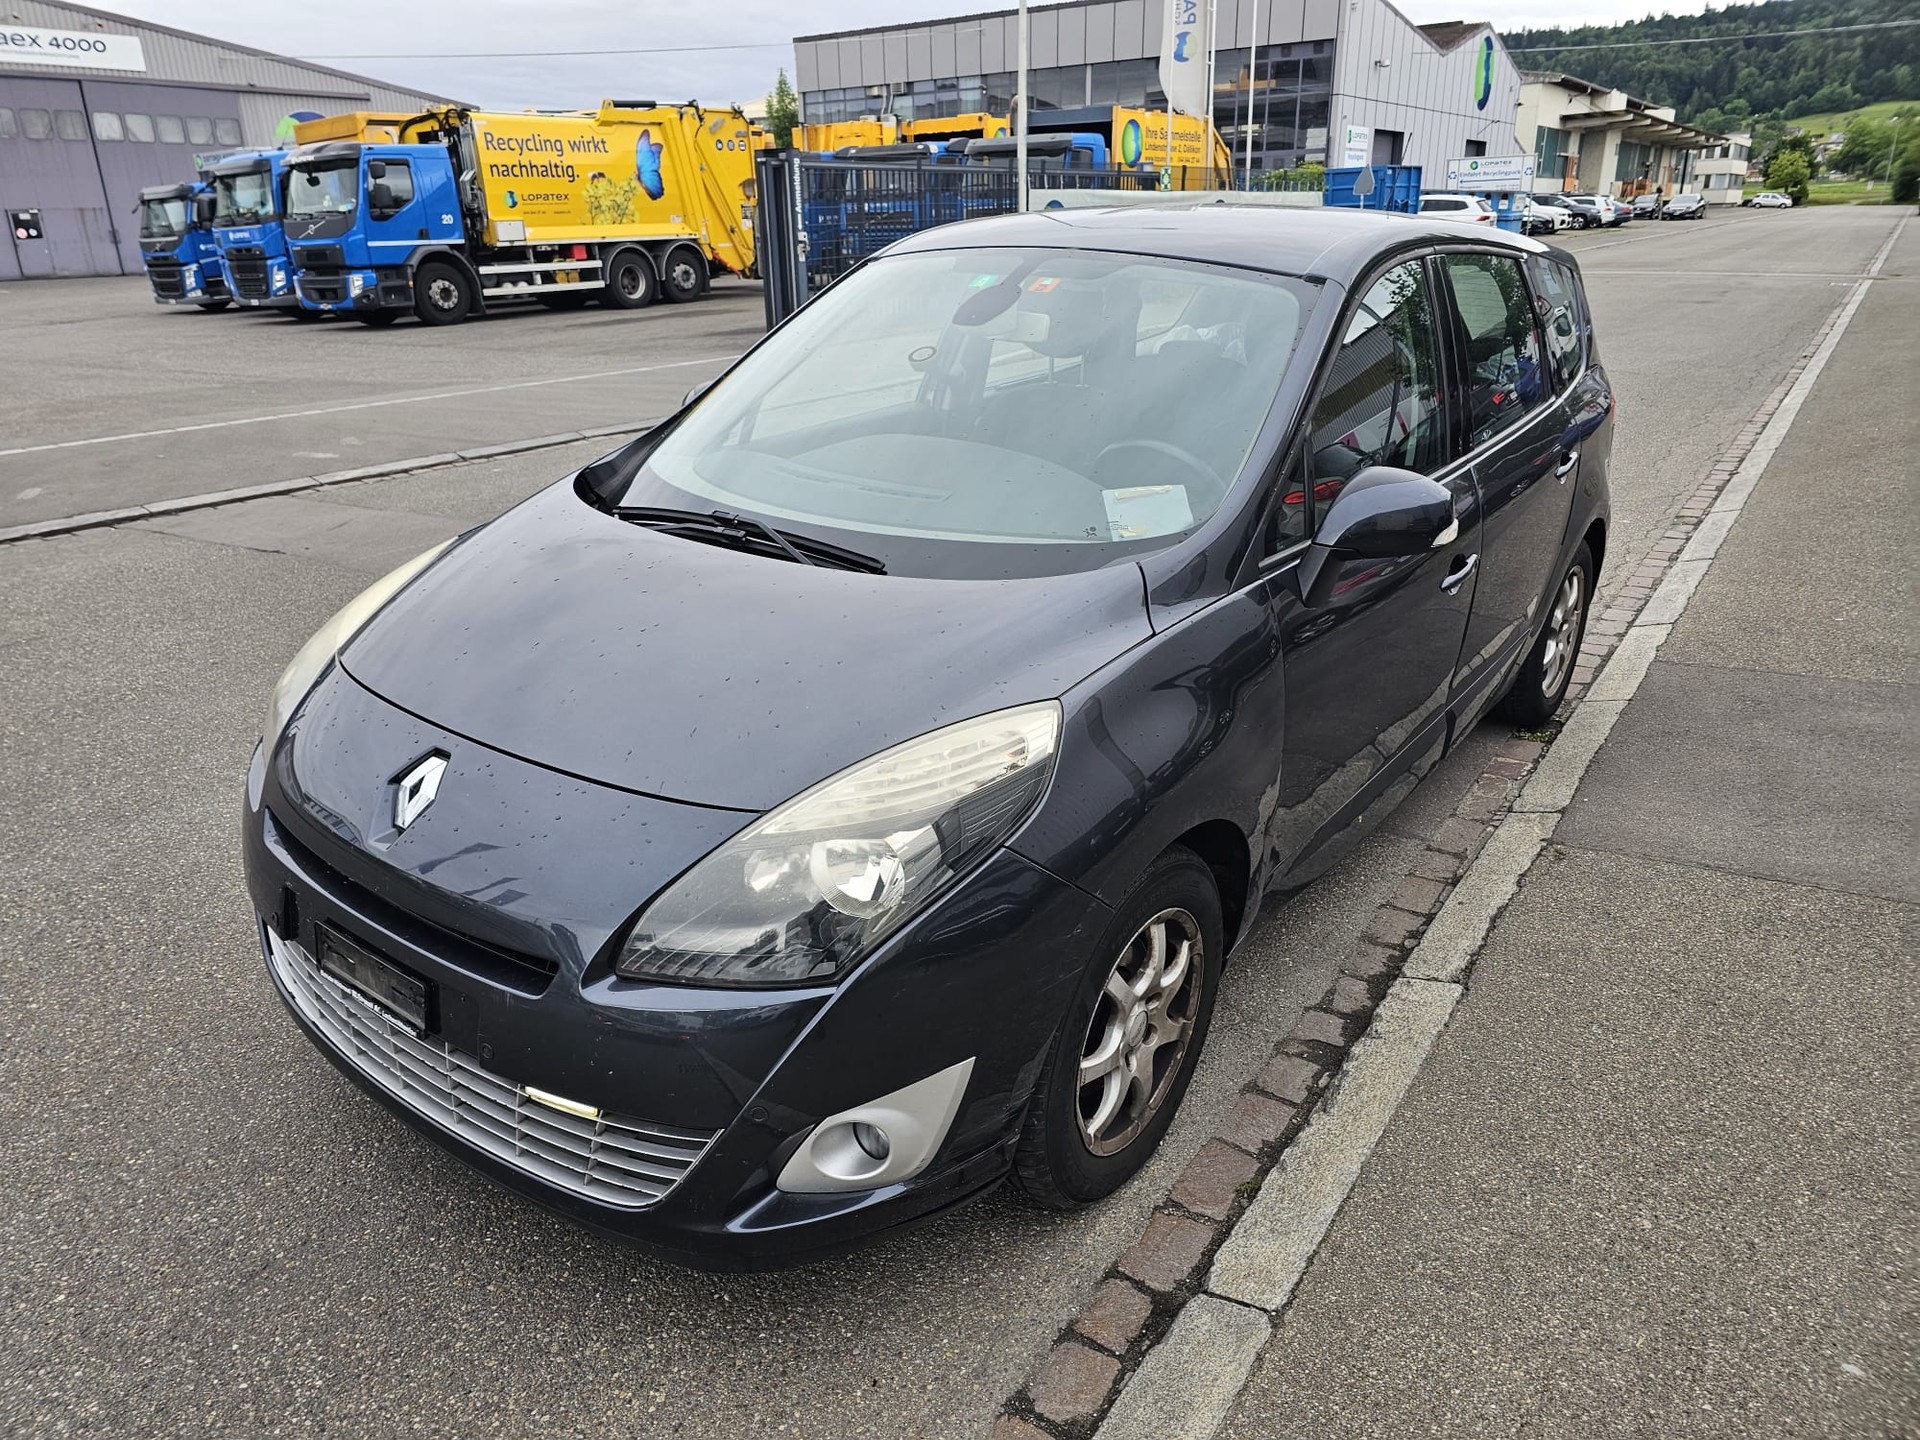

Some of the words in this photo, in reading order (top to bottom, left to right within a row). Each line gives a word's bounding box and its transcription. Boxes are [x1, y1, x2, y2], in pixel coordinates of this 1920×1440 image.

[48, 36, 107, 53] 4000
[483, 132, 564, 157] Recycling
[568, 135, 609, 154] wirkt
[489, 159, 580, 183] nachhaltig.
[1460, 170, 1481, 178] Einfahrt
[1483, 169, 1521, 177] Recyclingpark
[793, 157, 803, 213] Anmeldung
[440, 213, 454, 225] 20
